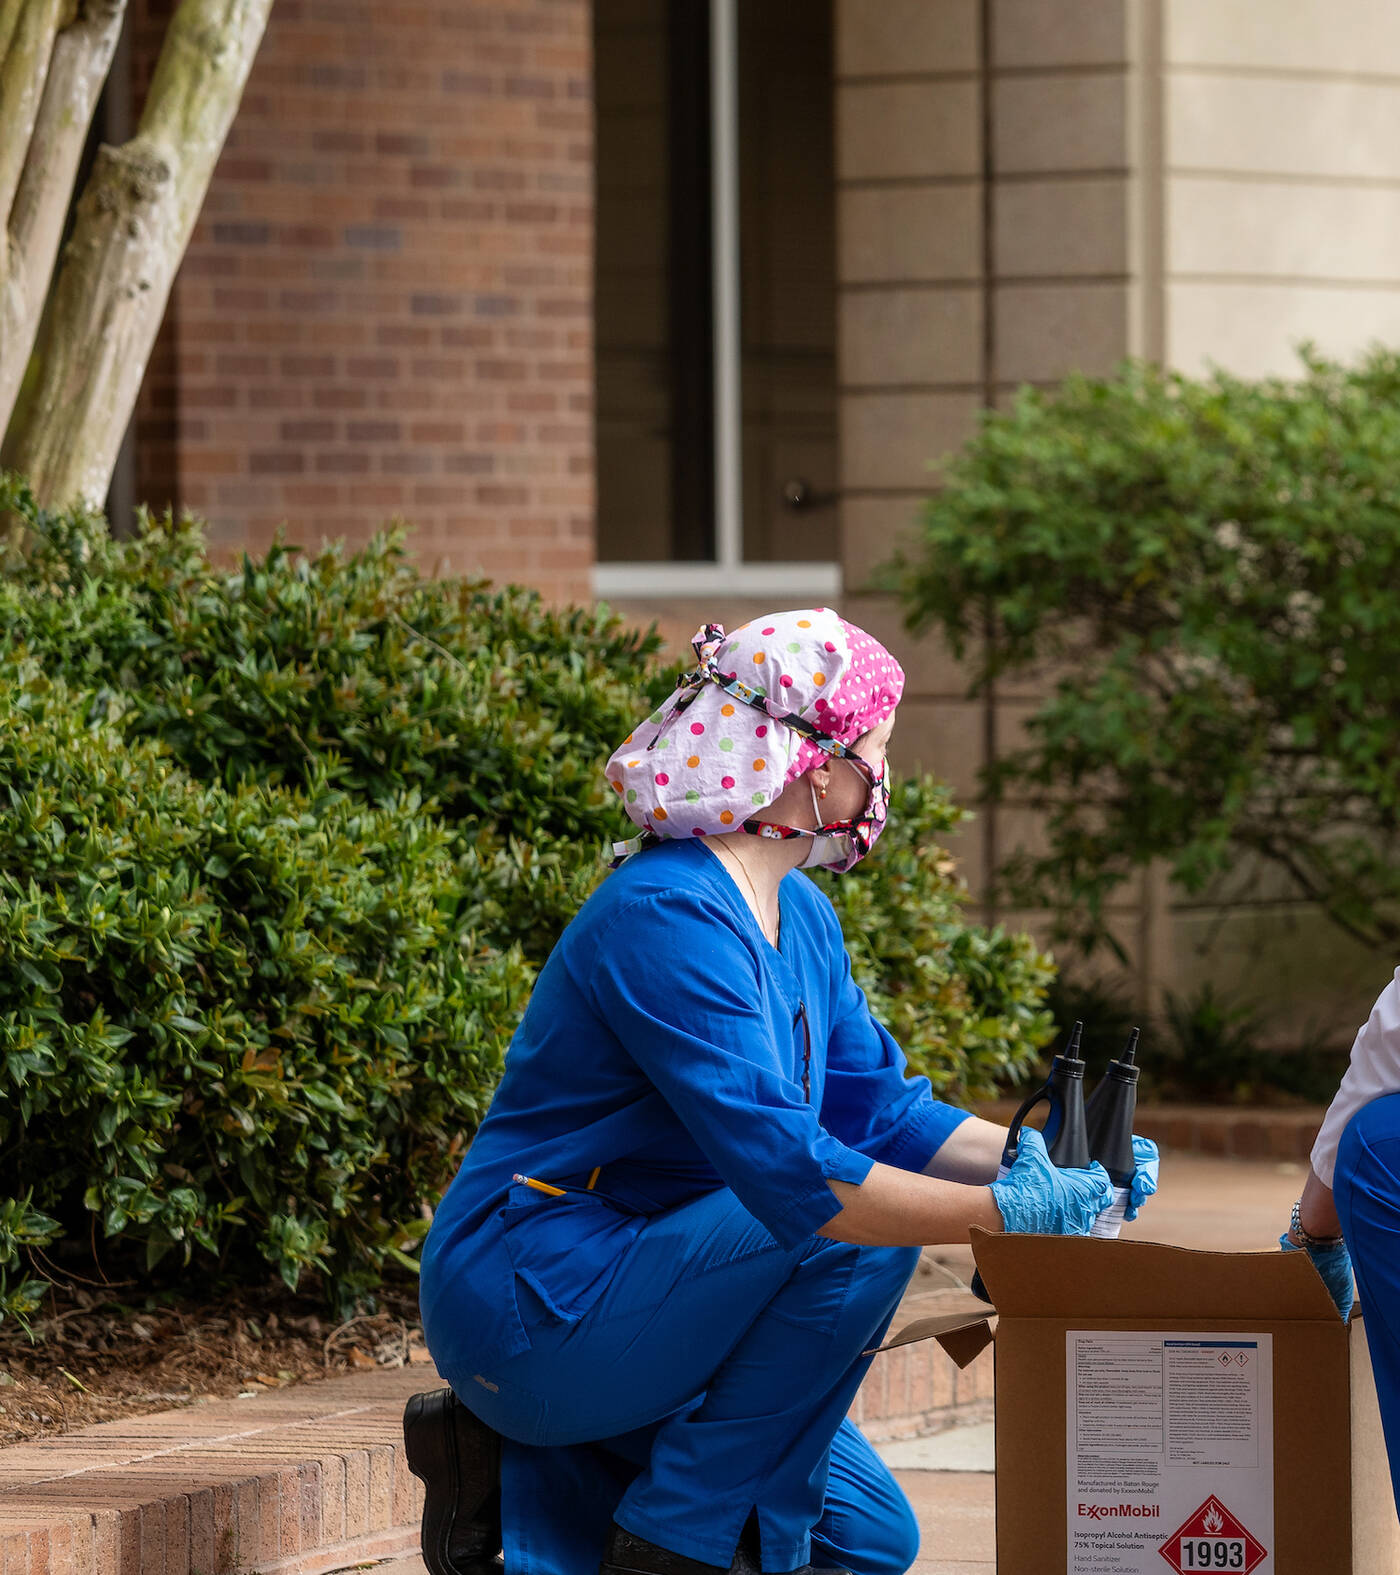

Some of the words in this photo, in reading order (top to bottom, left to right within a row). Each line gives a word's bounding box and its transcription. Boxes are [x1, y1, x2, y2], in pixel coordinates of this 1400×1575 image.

[1113, 1487, 1120, 1495] by
[1078, 1503, 1160, 1520] ExxonMobil
[1074, 1531, 1106, 1540] Isopropyl
[1134, 1532, 1168, 1541] Antiseptic
[1090, 1542, 1115, 1550] Topical
[1116, 1542, 1145, 1550] Solution
[1074, 1554, 1092, 1562] Hand
[1183, 1541, 1243, 1568] 1993
